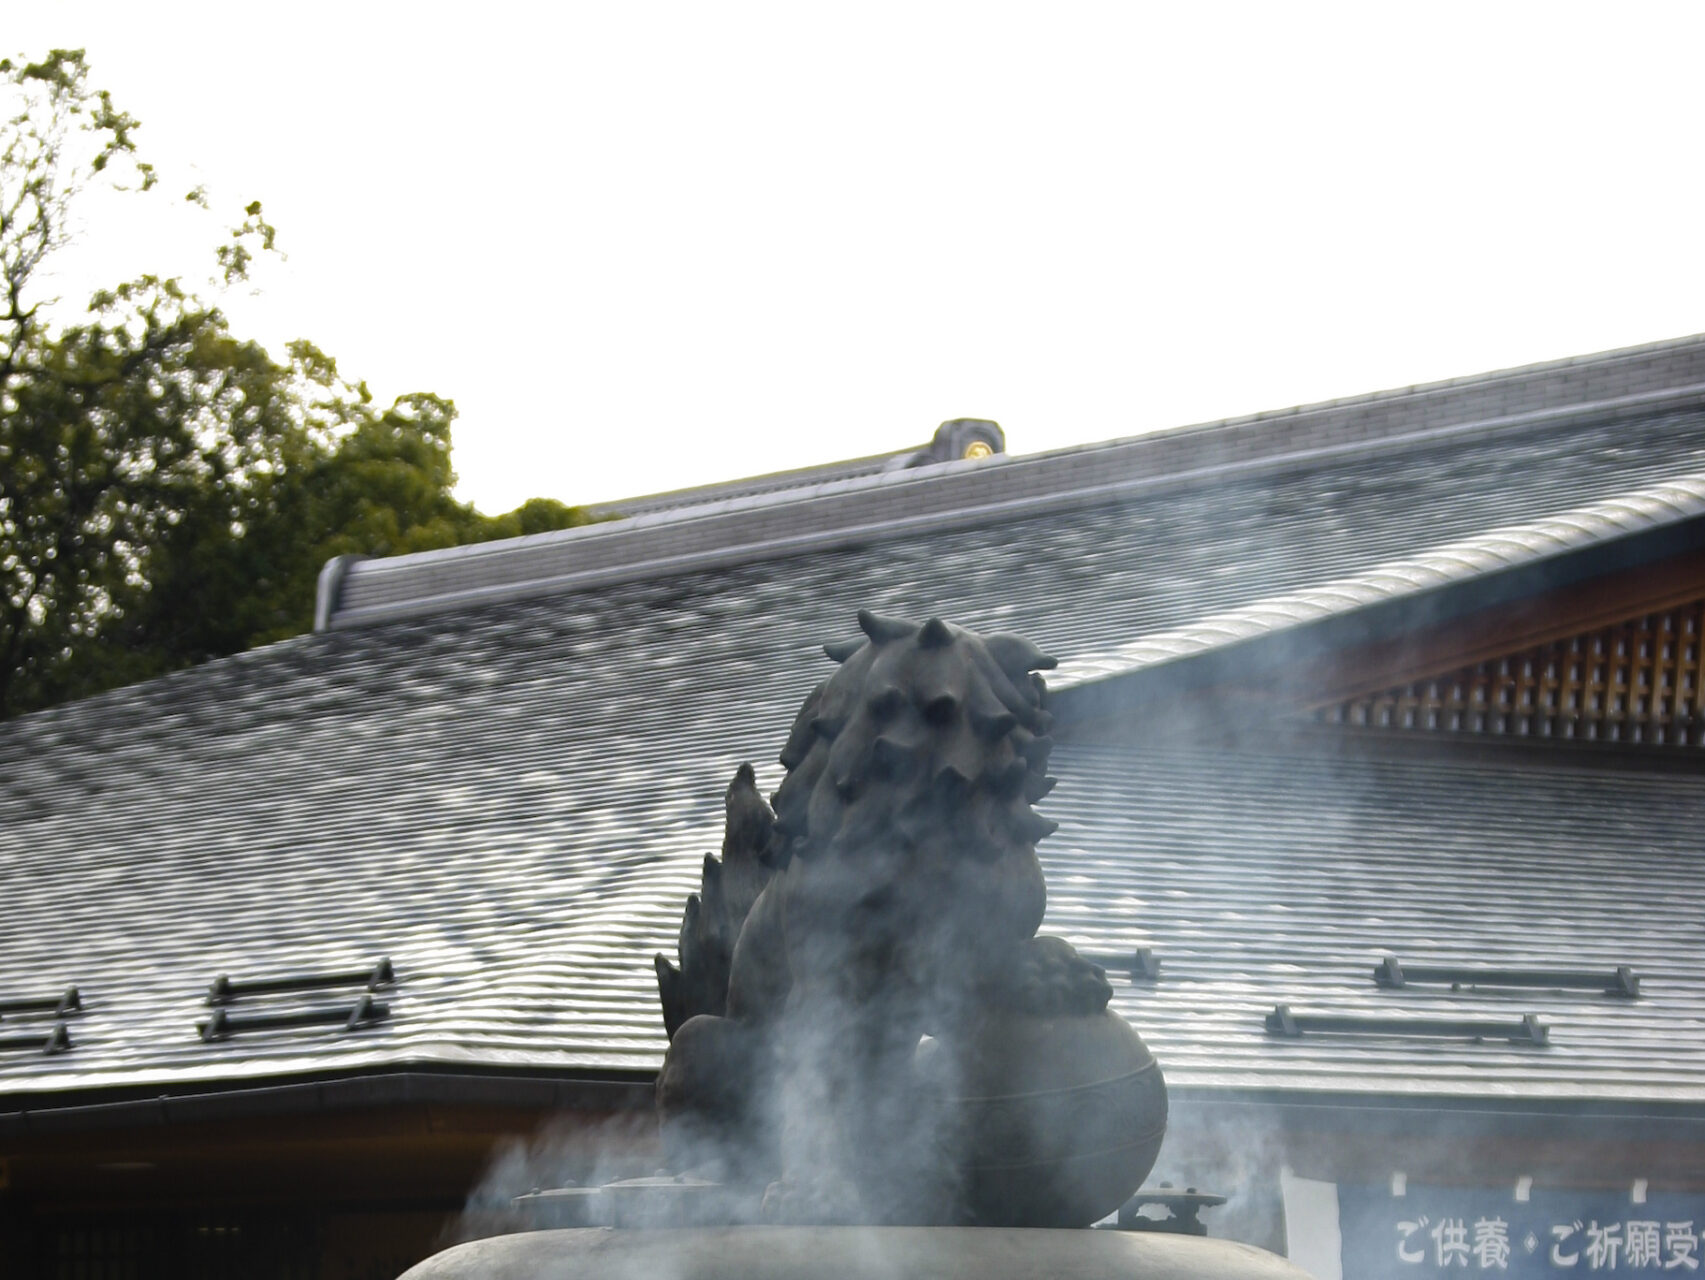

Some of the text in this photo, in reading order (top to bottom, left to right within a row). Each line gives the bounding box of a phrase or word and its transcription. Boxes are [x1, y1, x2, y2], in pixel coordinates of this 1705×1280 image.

[1397, 1215, 1705, 1270] ご供養 ご祈願受
